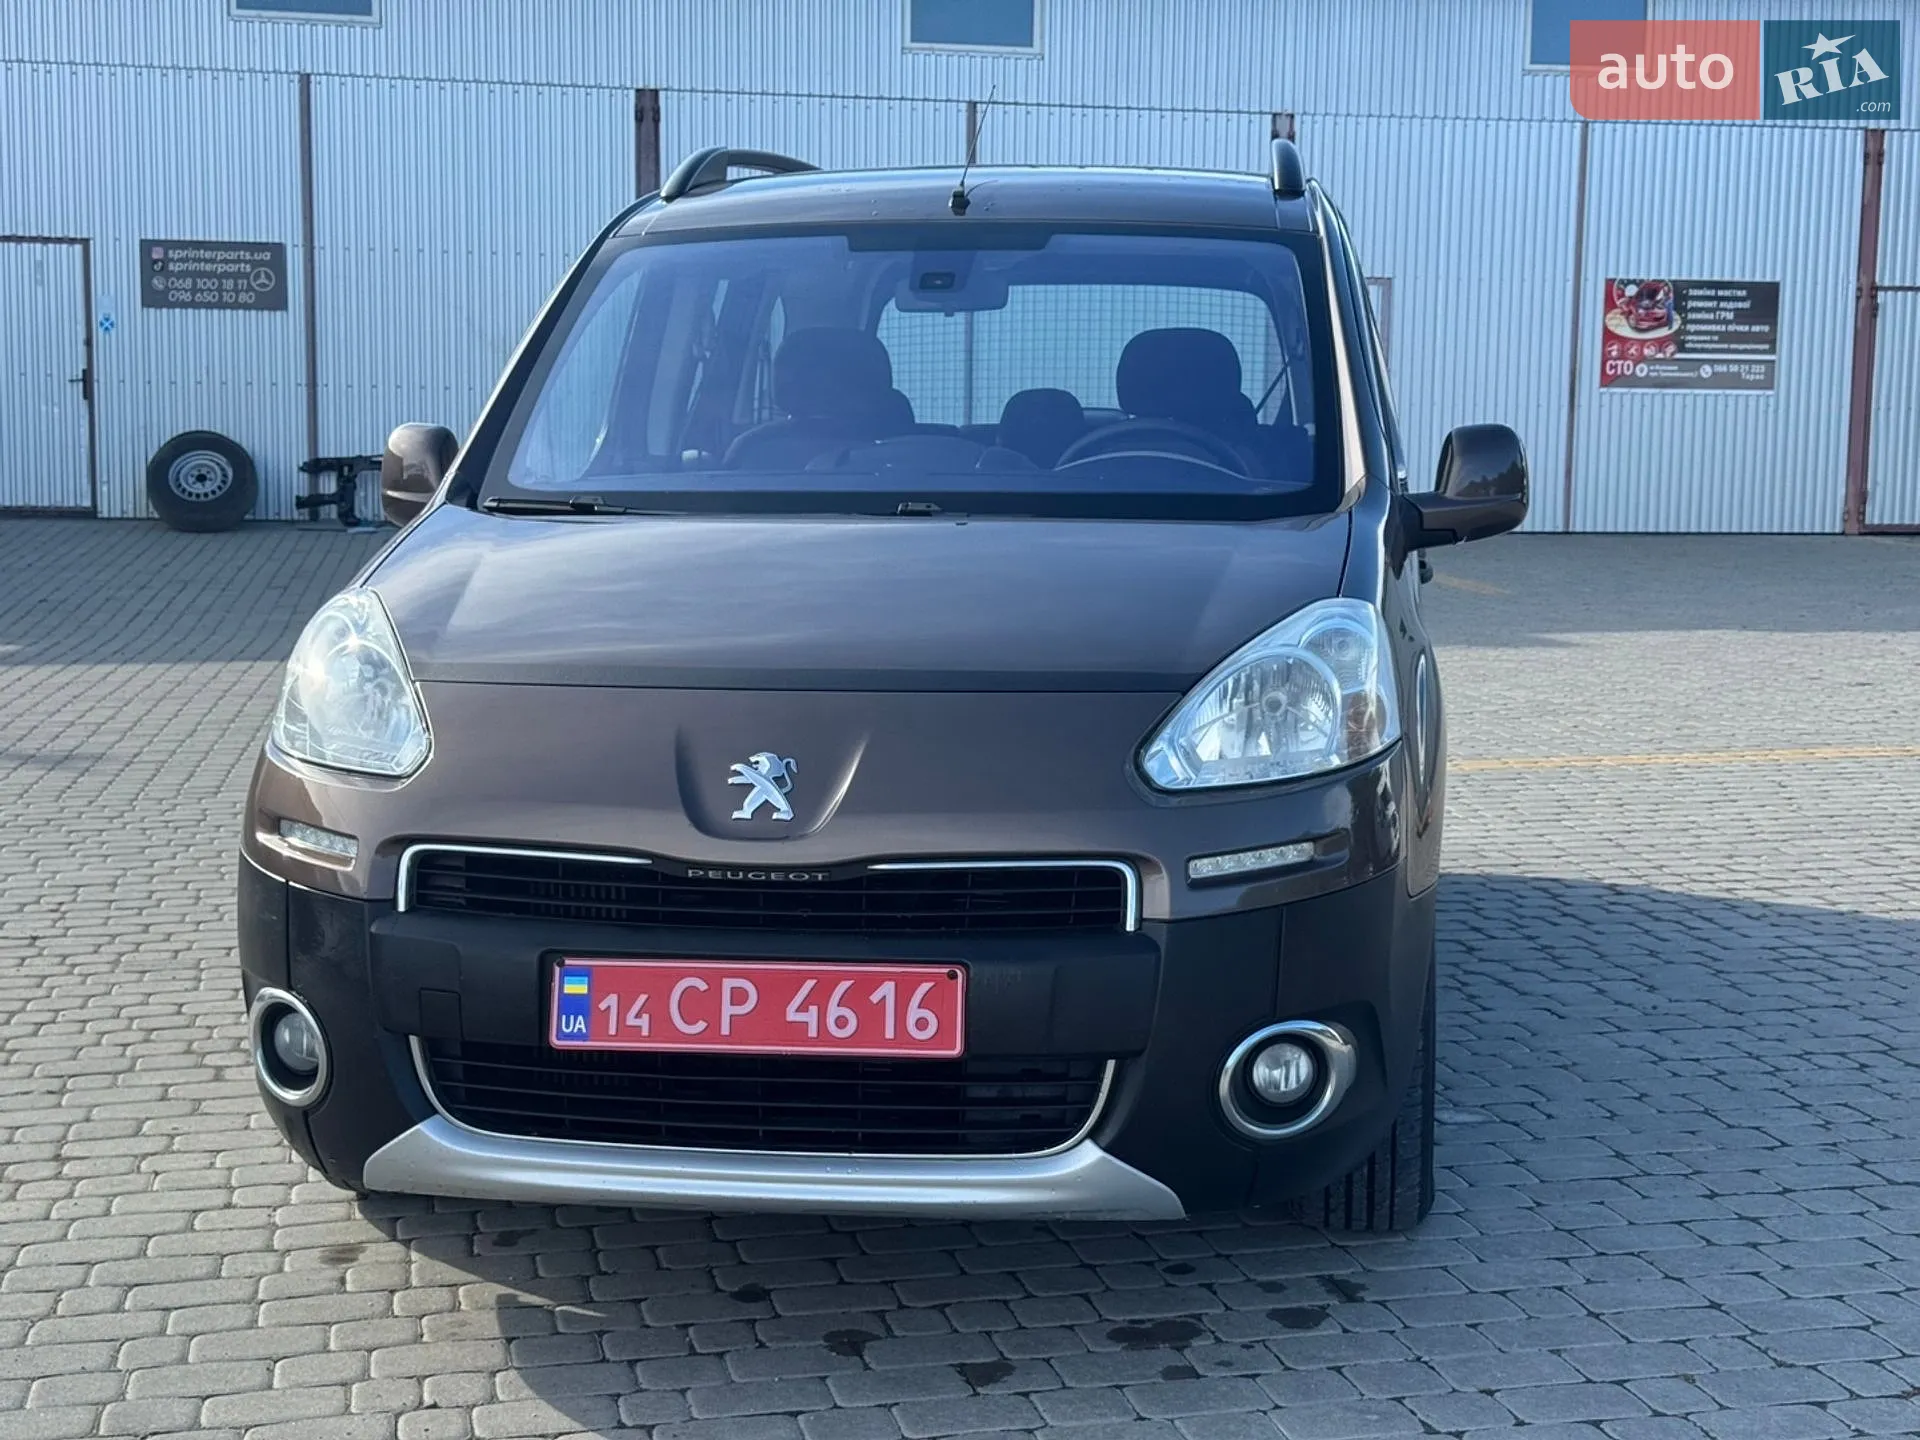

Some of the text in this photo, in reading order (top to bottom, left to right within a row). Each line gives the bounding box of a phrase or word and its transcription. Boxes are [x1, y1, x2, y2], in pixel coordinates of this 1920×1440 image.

[168, 247, 271, 262] sprinterparts.ua
[168, 260, 251, 274] sprinterparts
[168, 277, 192, 290] 068
[196, 278, 218, 290] 100
[222, 279, 234, 290] 18
[168, 290, 256, 304] 096 650 10 80
[1606, 360, 1634, 375] СТО
[688, 868, 830, 881] PEUGEOT
[598, 977, 940, 1041] 14 CP 4616
[561, 1014, 587, 1034] UA
